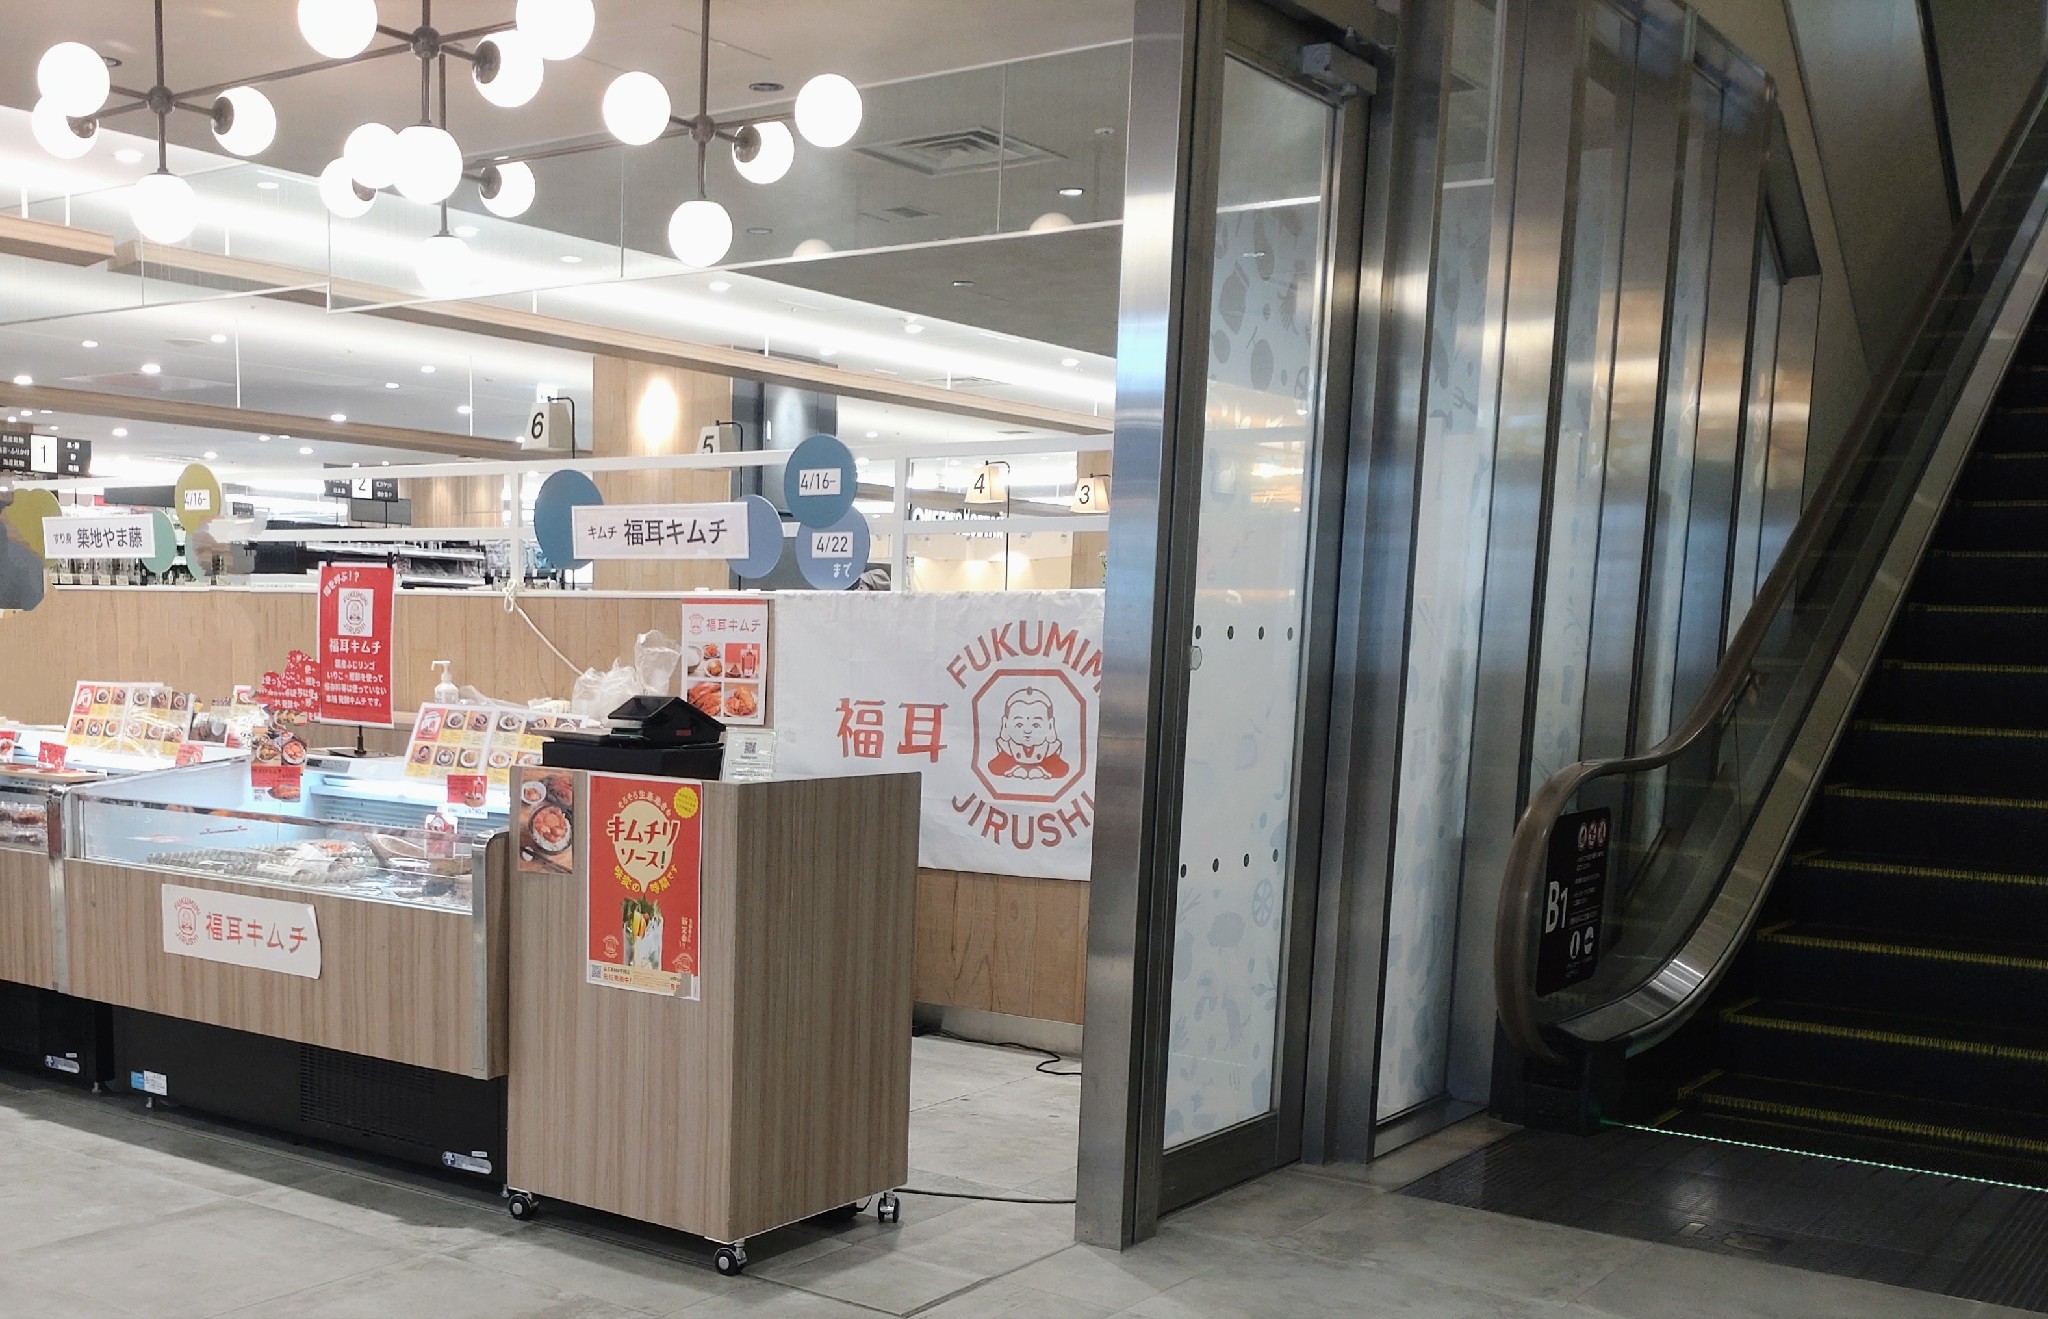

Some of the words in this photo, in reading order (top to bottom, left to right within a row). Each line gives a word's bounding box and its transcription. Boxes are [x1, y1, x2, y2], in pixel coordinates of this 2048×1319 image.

[531, 412, 545, 440] 6
[41, 444, 46, 464] 1
[702, 435, 715, 454] 5
[973, 473, 985, 494] 4
[1079, 485, 1091, 504] 3
[53, 533, 72, 545] すり身
[77, 526, 143, 549] 築地やま藤
[587, 525, 618, 541] キムチ
[624, 518, 728, 547] 福耳キムチ
[816, 537, 849, 553] 4/22
[832, 562, 853, 579] まで
[706, 617, 761, 633] 福耳キムチ
[329, 637, 382, 655] 福耳キムチ
[836, 697, 949, 763] 福耳
[608, 816, 679, 847] キムチリ
[621, 848, 666, 870] ソース!
[1545, 881, 1569, 934] B1
[206, 912, 308, 954] 福耳キムチ
